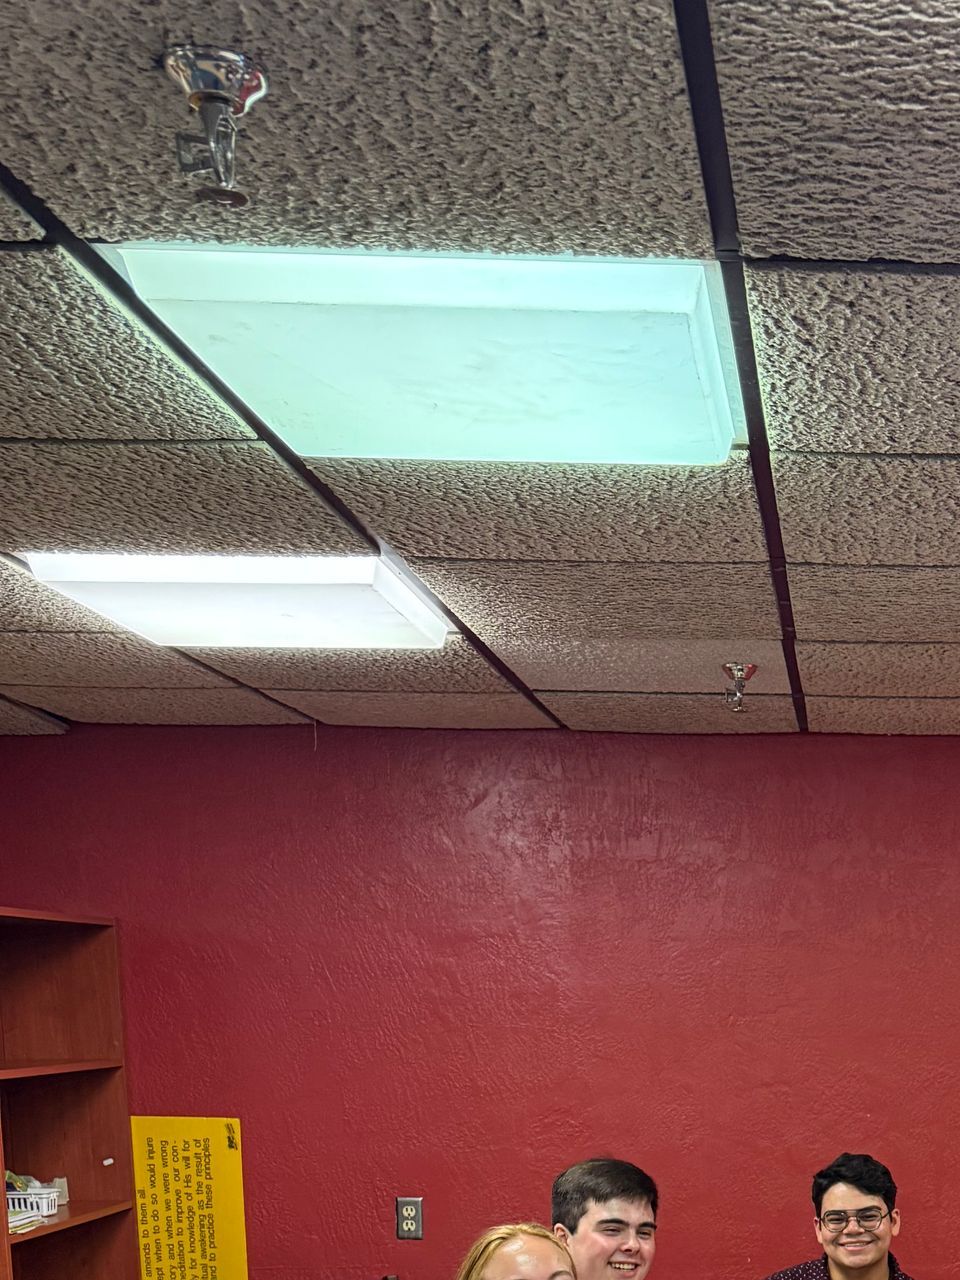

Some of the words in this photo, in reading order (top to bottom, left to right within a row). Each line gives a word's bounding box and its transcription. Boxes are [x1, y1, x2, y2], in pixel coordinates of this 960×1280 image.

[146, 1137, 155, 1160] injure
[182, 1140, 190, 1151] for
[192, 1139, 201, 1148] of
[160, 1140, 169, 1168] wrong
[202, 1138, 213, 1180] principles
[182, 1156, 190, 1169] will
[194, 1153, 202, 1177] result
[147, 1164, 156, 1189] would
[184, 1174, 192, 1188] His
[195, 1181, 203, 1195] the
[151, 1194, 158, 1204] so
[184, 1193, 193, 1201] of
[205, 1184, 213, 1209] these
[165, 1199, 171, 1211] we
[175, 1189, 184, 1223] improve
[198, 1200, 204, 1210] as
[140, 1203, 148, 1224] them
[151, 1210, 159, 1221] do
[142, 1229, 149, 1238] to
[153, 1225, 160, 1234] to
[165, 1216, 173, 1239] when
[176, 1227, 183, 1236] to
[186, 1206, 195, 1253] knowledge
[207, 1214, 217, 1248] practice
[199, 1215, 207, 1259] awakening
[154, 1239, 162, 1262] when
[166, 1244, 175, 1260] and
[209, 1253, 216, 1261] to
[143, 1243, 152, 1277] amends
[189, 1258, 197, 1269] for
